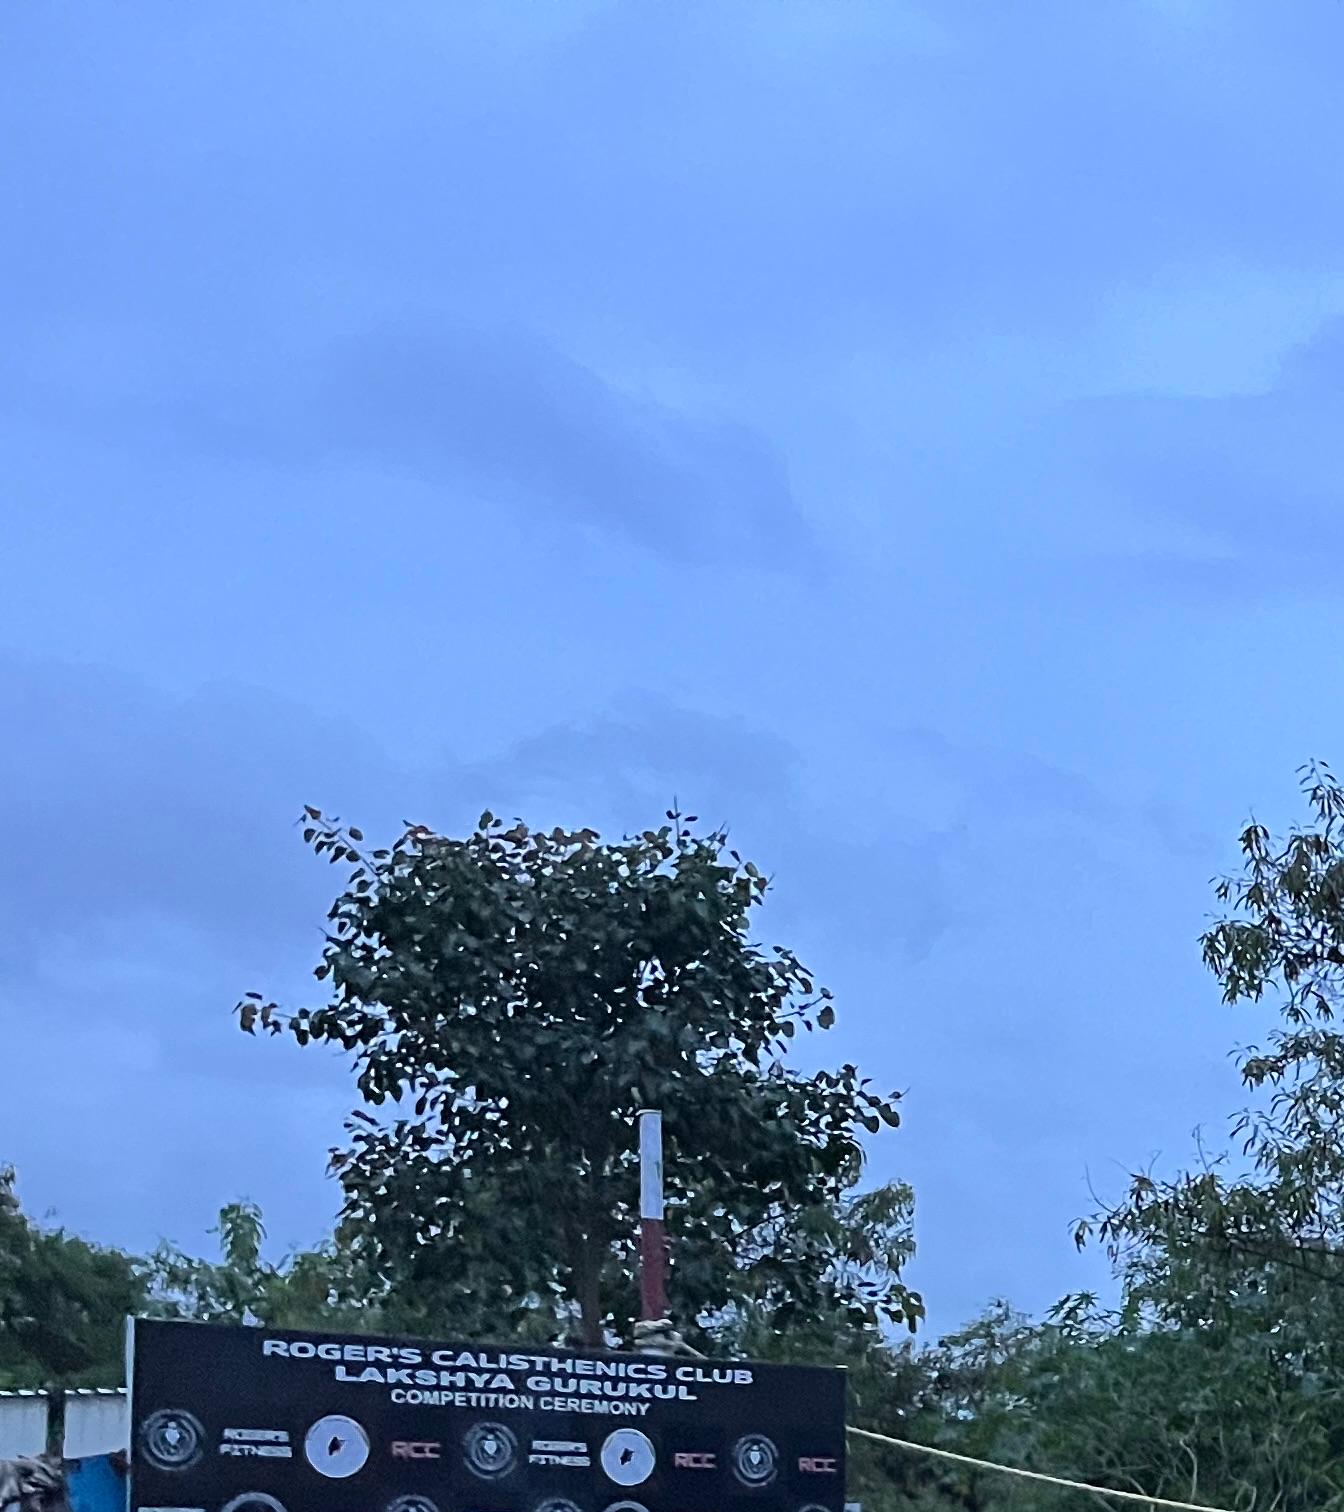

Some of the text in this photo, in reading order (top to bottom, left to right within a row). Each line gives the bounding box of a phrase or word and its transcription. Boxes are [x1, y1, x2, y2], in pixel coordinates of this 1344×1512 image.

[263, 1339, 754, 1386] ROGER'S CALISTHENICS CLUB
[335, 1365, 698, 1401] LAKSHYA GURUKUL
[391, 1389, 651, 1416] COMPETITION CEREMONY
